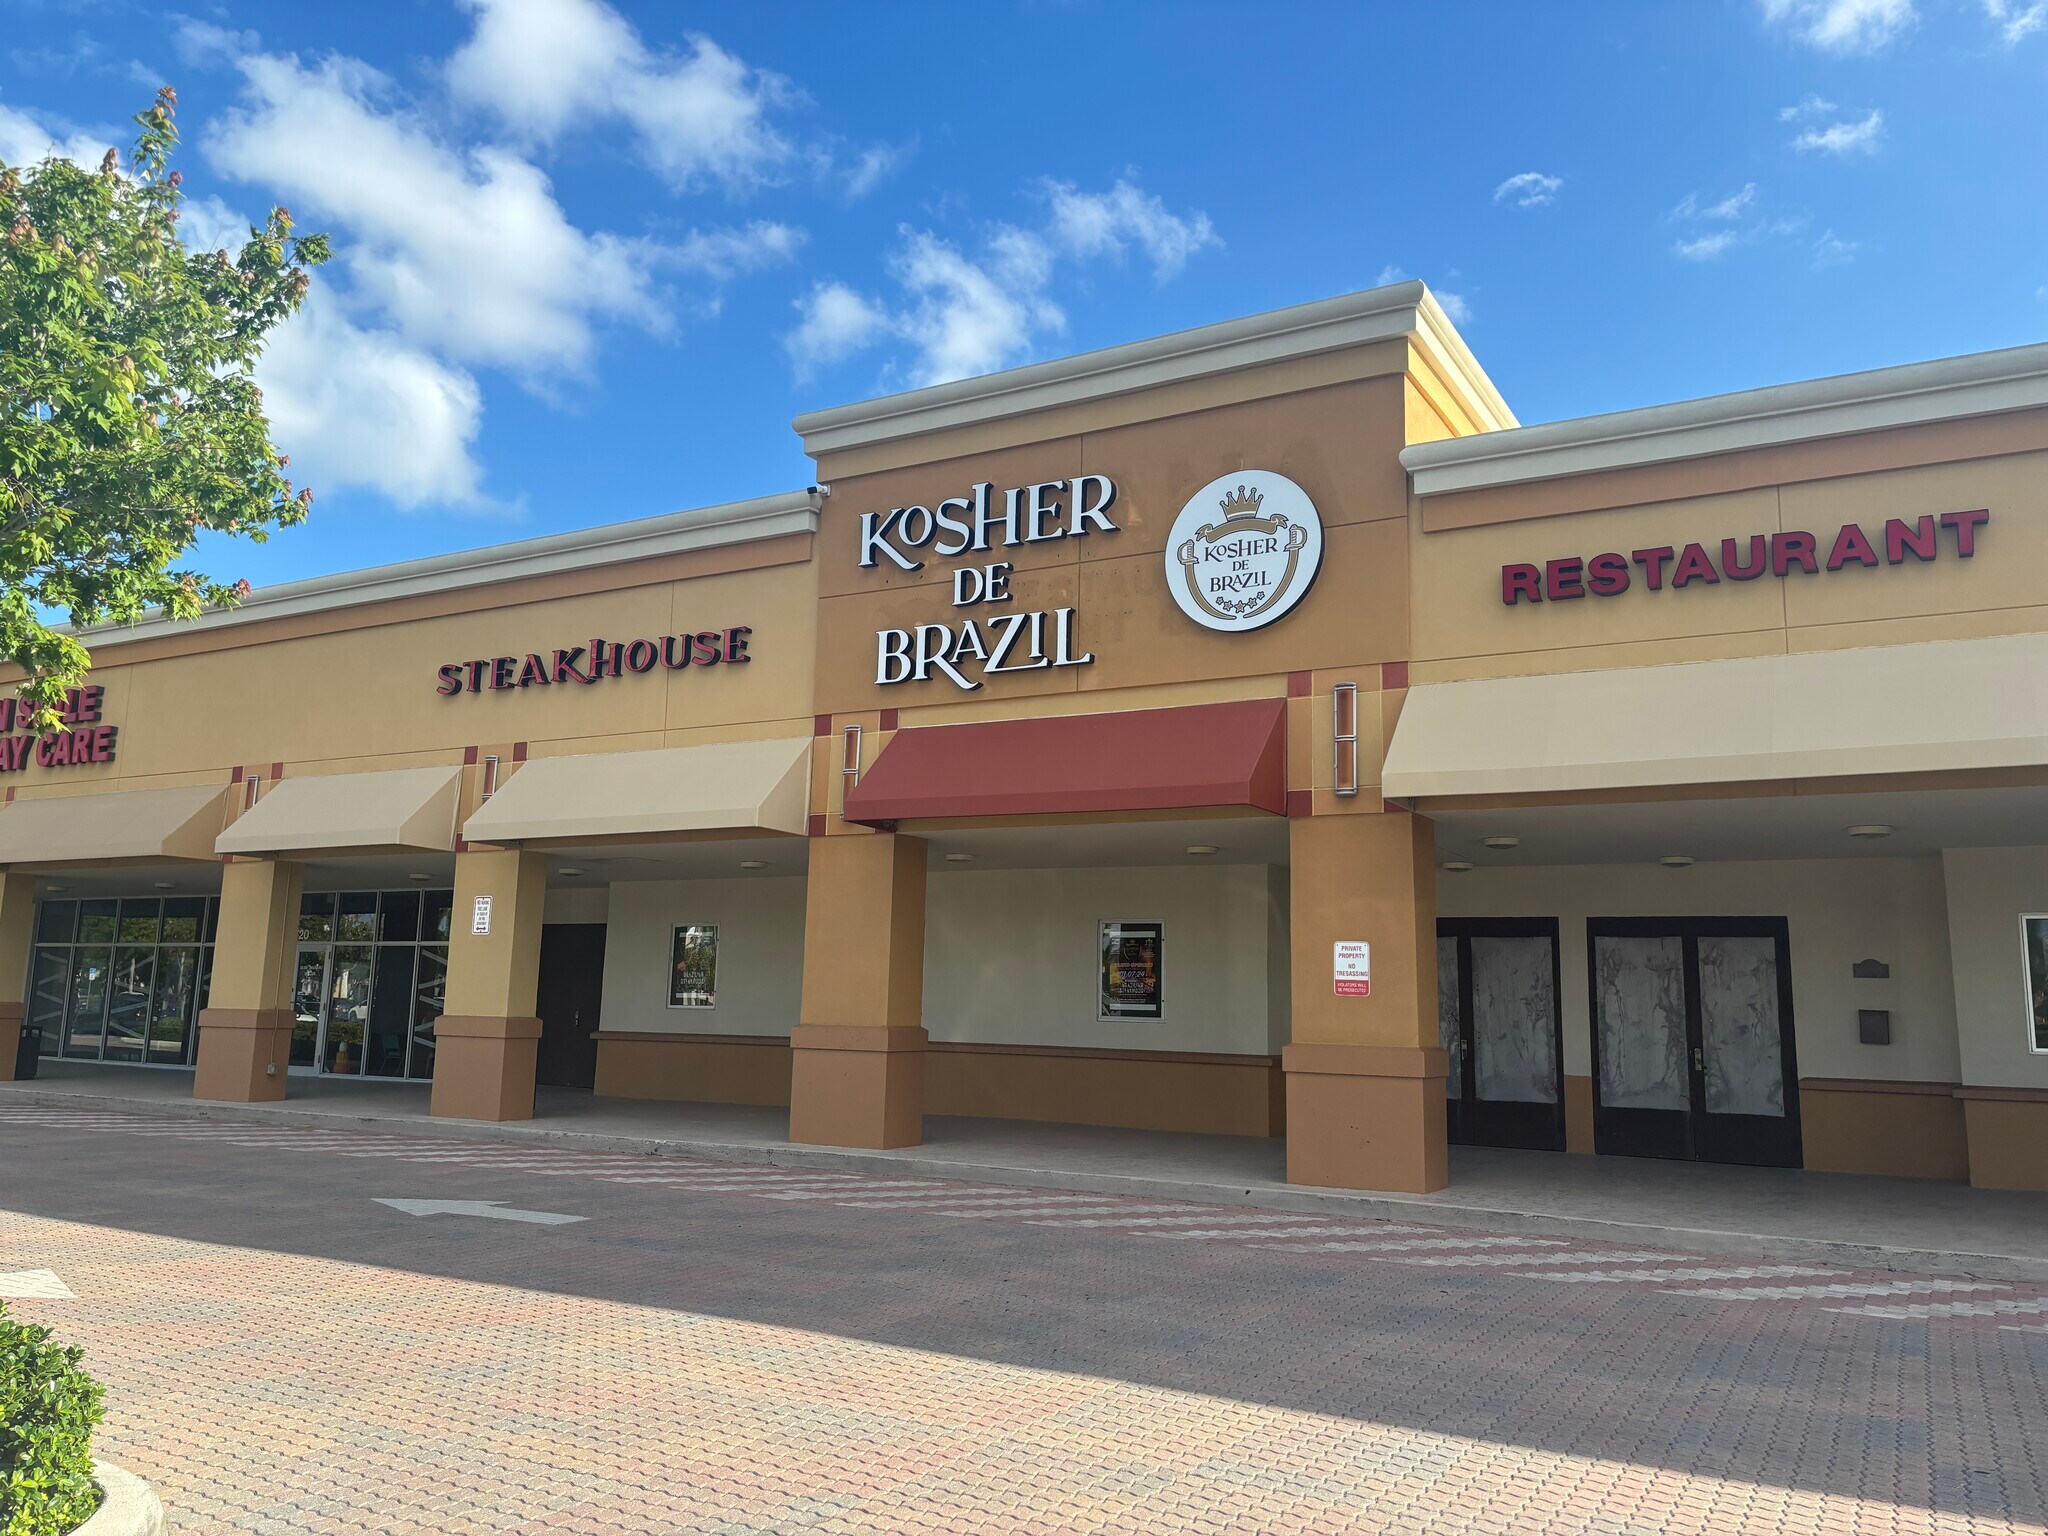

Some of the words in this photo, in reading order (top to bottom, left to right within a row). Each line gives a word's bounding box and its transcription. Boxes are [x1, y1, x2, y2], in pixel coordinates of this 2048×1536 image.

[858, 474, 1121, 571] KOSHER
[1204, 537, 1278, 563] KOSHER
[1232, 559, 1250, 572] DE
[1501, 508, 1990, 605] RESTAURANT
[952, 561, 1014, 608] DE
[1209, 570, 1272, 593] BRAZIL
[436, 625, 753, 696] STEAKHOUSE
[874, 607, 1095, 690] BRAZIL
[16, 685, 105, 729] SLE
[36, 725, 118, 768] CARE
